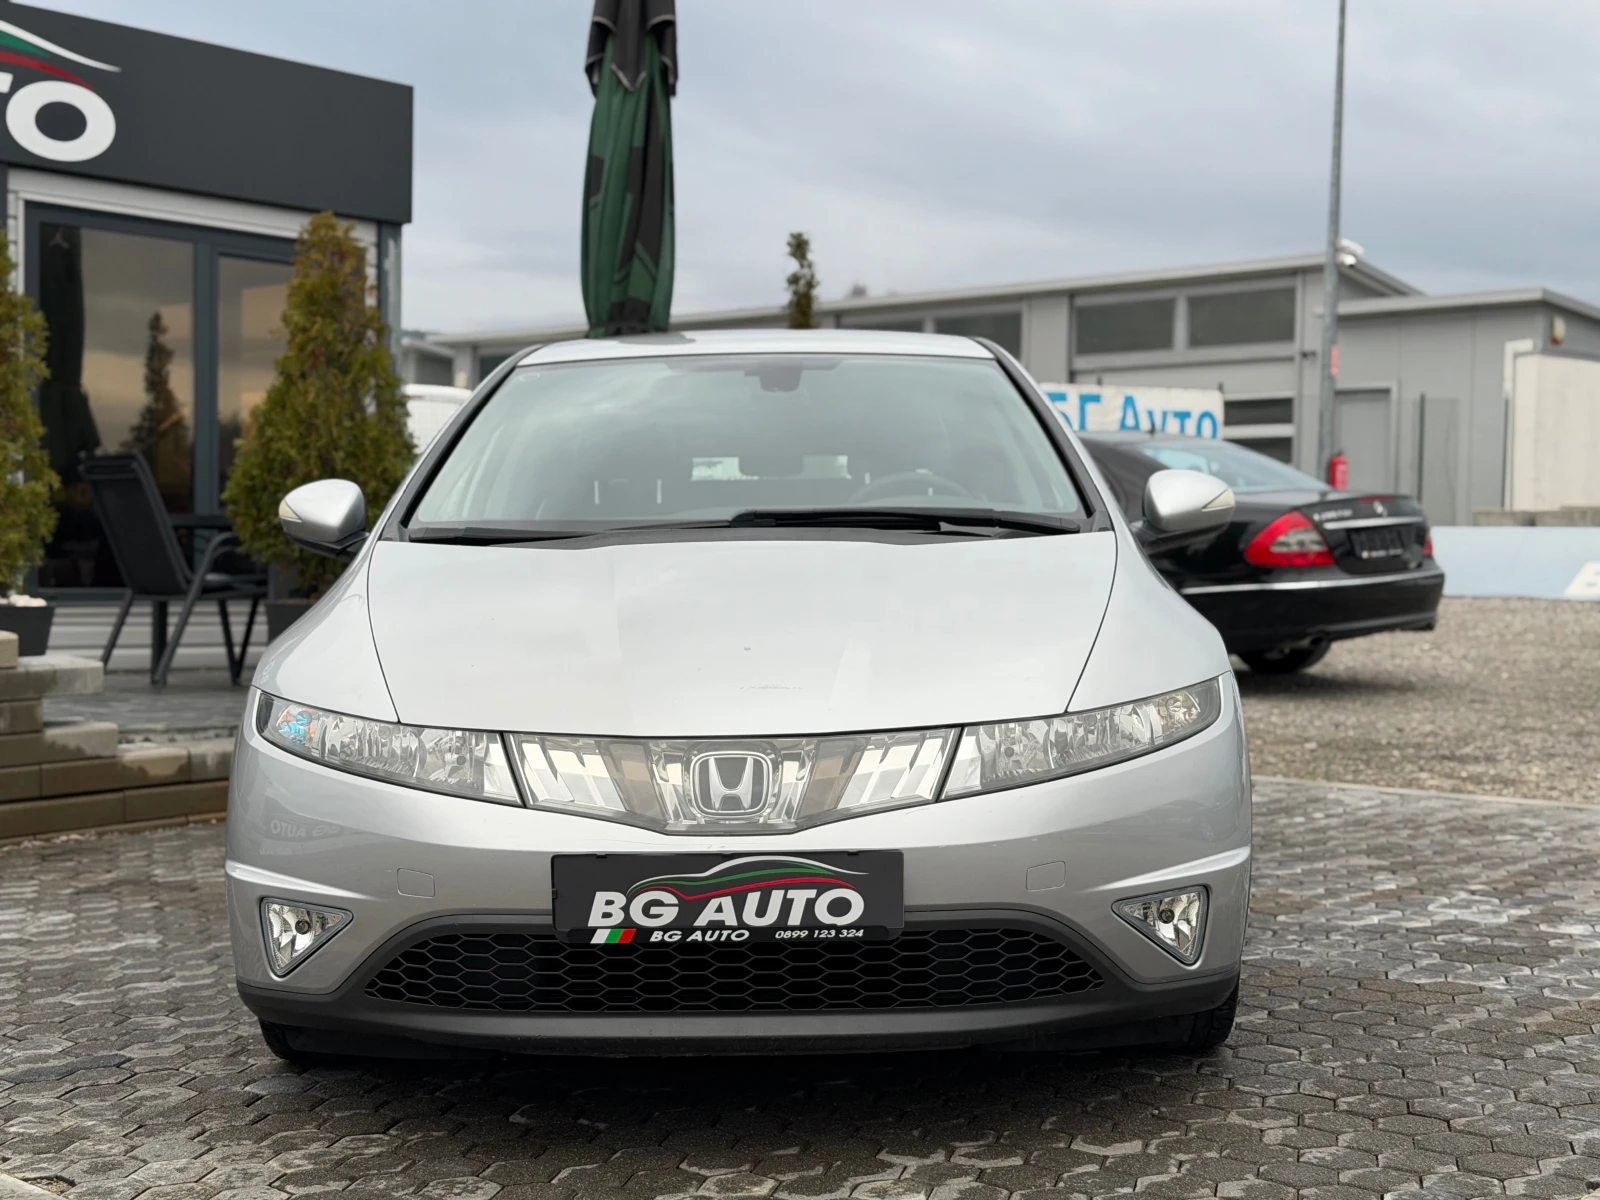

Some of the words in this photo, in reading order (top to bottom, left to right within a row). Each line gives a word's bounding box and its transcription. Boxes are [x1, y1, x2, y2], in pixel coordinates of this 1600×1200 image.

[0, 71, 116, 162] O
[588, 890, 679, 927] BG
[693, 888, 865, 927] AUTO
[650, 930, 682, 942] BG
[686, 929, 750, 942] AUTO
[775, 930, 809, 939] 0899
[813, 929, 836, 938] 123
[838, 929, 864, 937] 324
